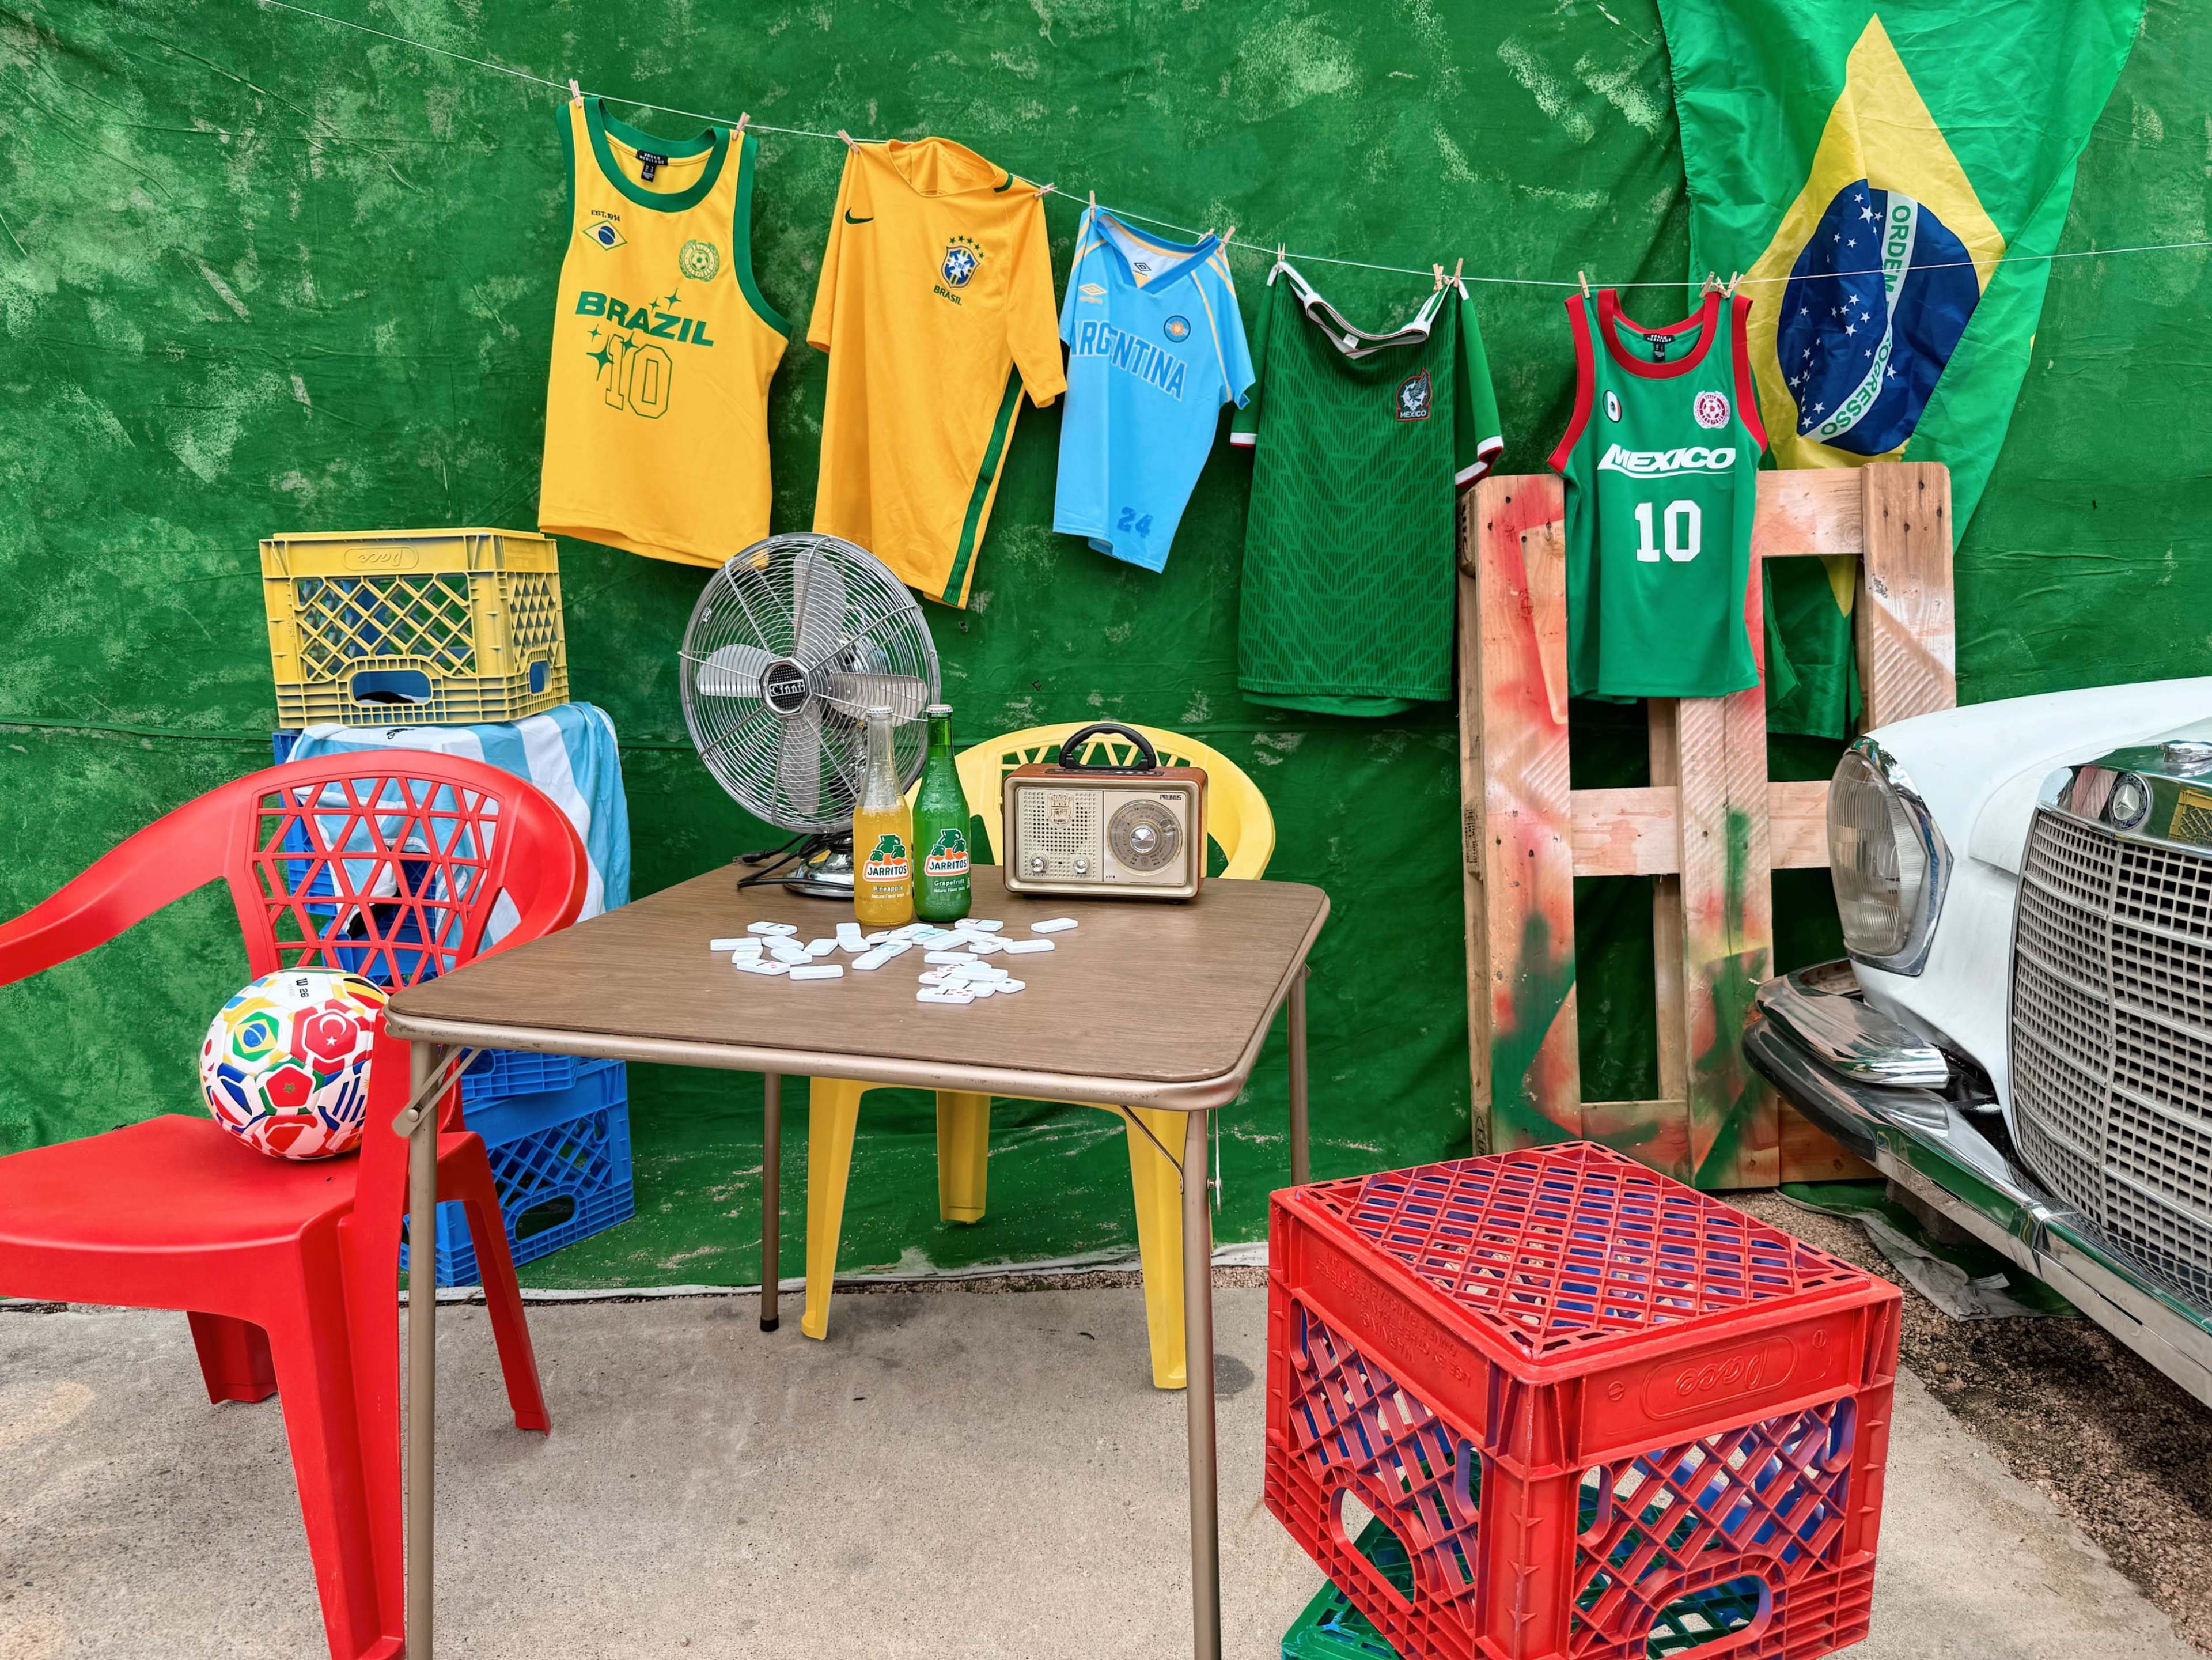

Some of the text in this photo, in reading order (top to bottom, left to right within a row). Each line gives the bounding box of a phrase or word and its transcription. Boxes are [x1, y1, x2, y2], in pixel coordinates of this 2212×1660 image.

[933, 285, 962, 306] BRASIL
[575, 291, 714, 347] BRAZIL
[1069, 320, 1187, 402] RGNTINA
[605, 334, 673, 419] 10
[1820, 338, 1891, 436] OGRESSO
[1400, 410, 1427, 418] MEXICO
[1597, 443, 1736, 472] MEXICO
[1117, 506, 1154, 538] 24
[1634, 500, 1702, 562] 10
[867, 865, 907, 876] JARRITOS
[929, 859, 967, 870] JARRITOS
[934, 879, 964, 887] Grapefruit
[299, 988, 309, 997] 26
